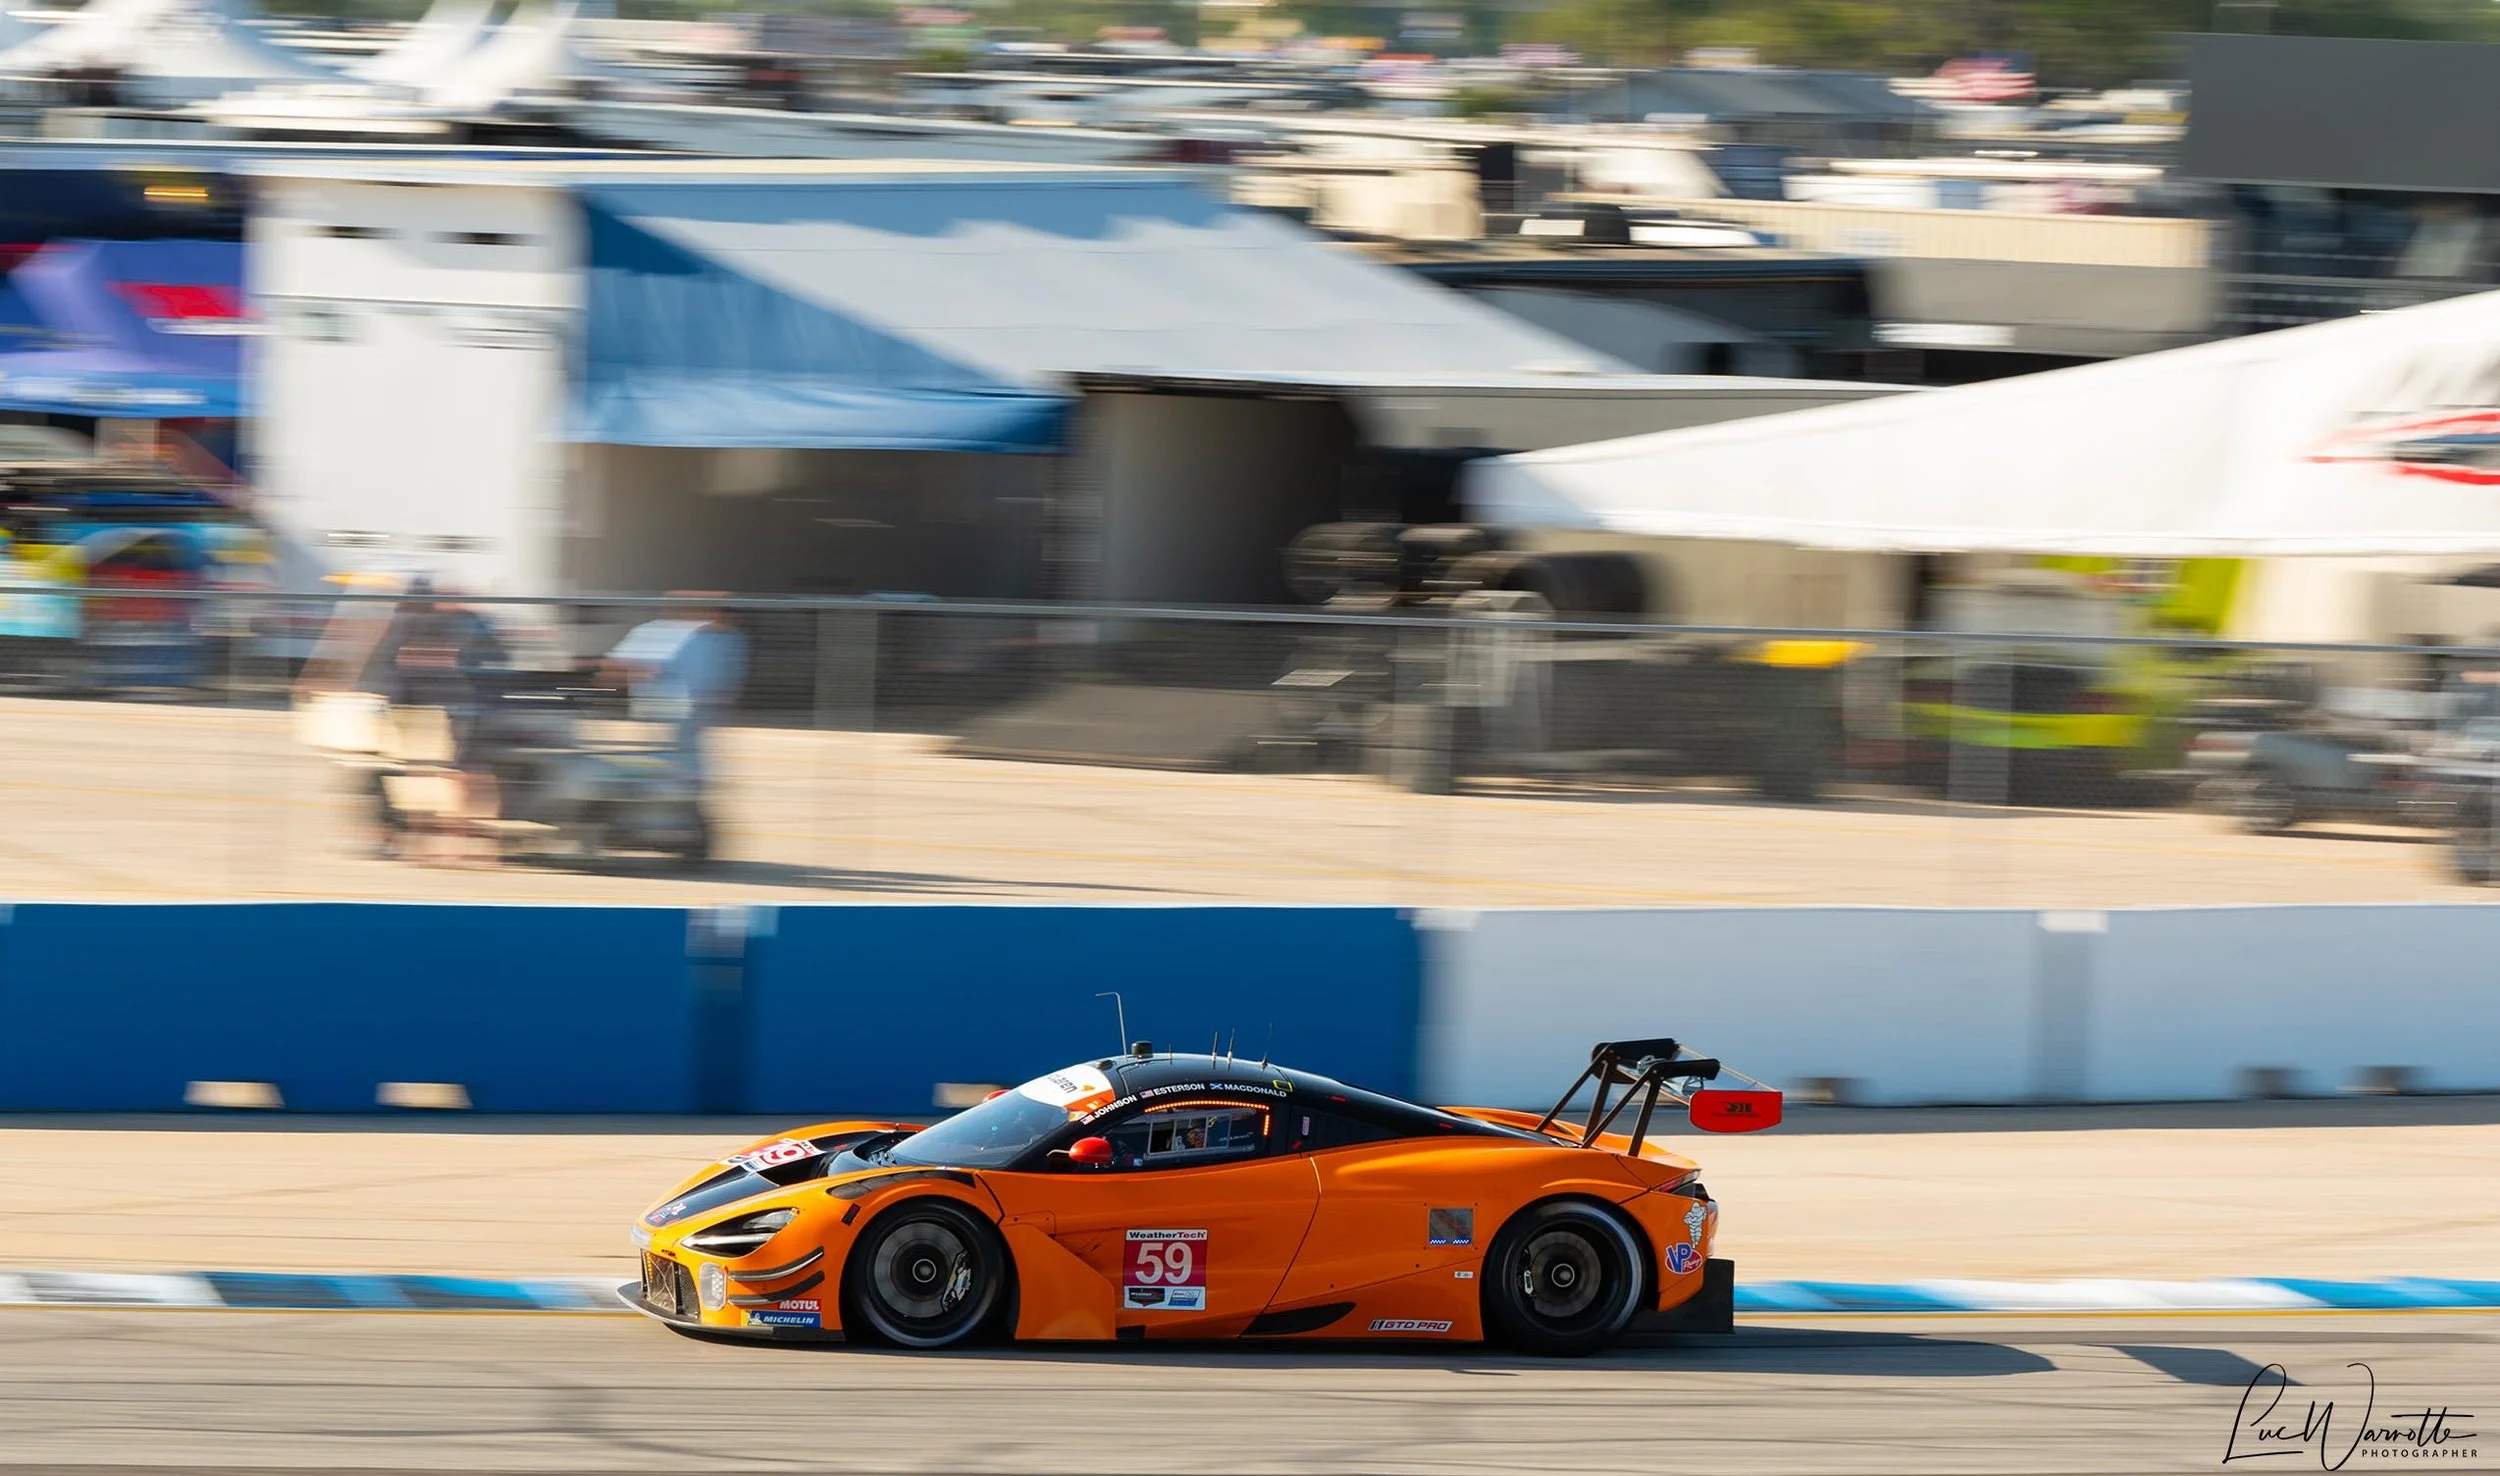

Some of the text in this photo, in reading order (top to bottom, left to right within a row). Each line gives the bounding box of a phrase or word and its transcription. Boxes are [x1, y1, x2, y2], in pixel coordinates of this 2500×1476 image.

[1094, 1083, 1287, 1119] JOHNSON ESTERSON MACDONALD
[1129, 1231, 1206, 1239] WeatherTech
[1666, 1243, 1692, 1273] VP
[1135, 1242, 1193, 1285] 59
[779, 1300, 820, 1310] MOTUL
[763, 1315, 815, 1325] MICHELIN
[1384, 1321, 1449, 1331] GTD PRO
